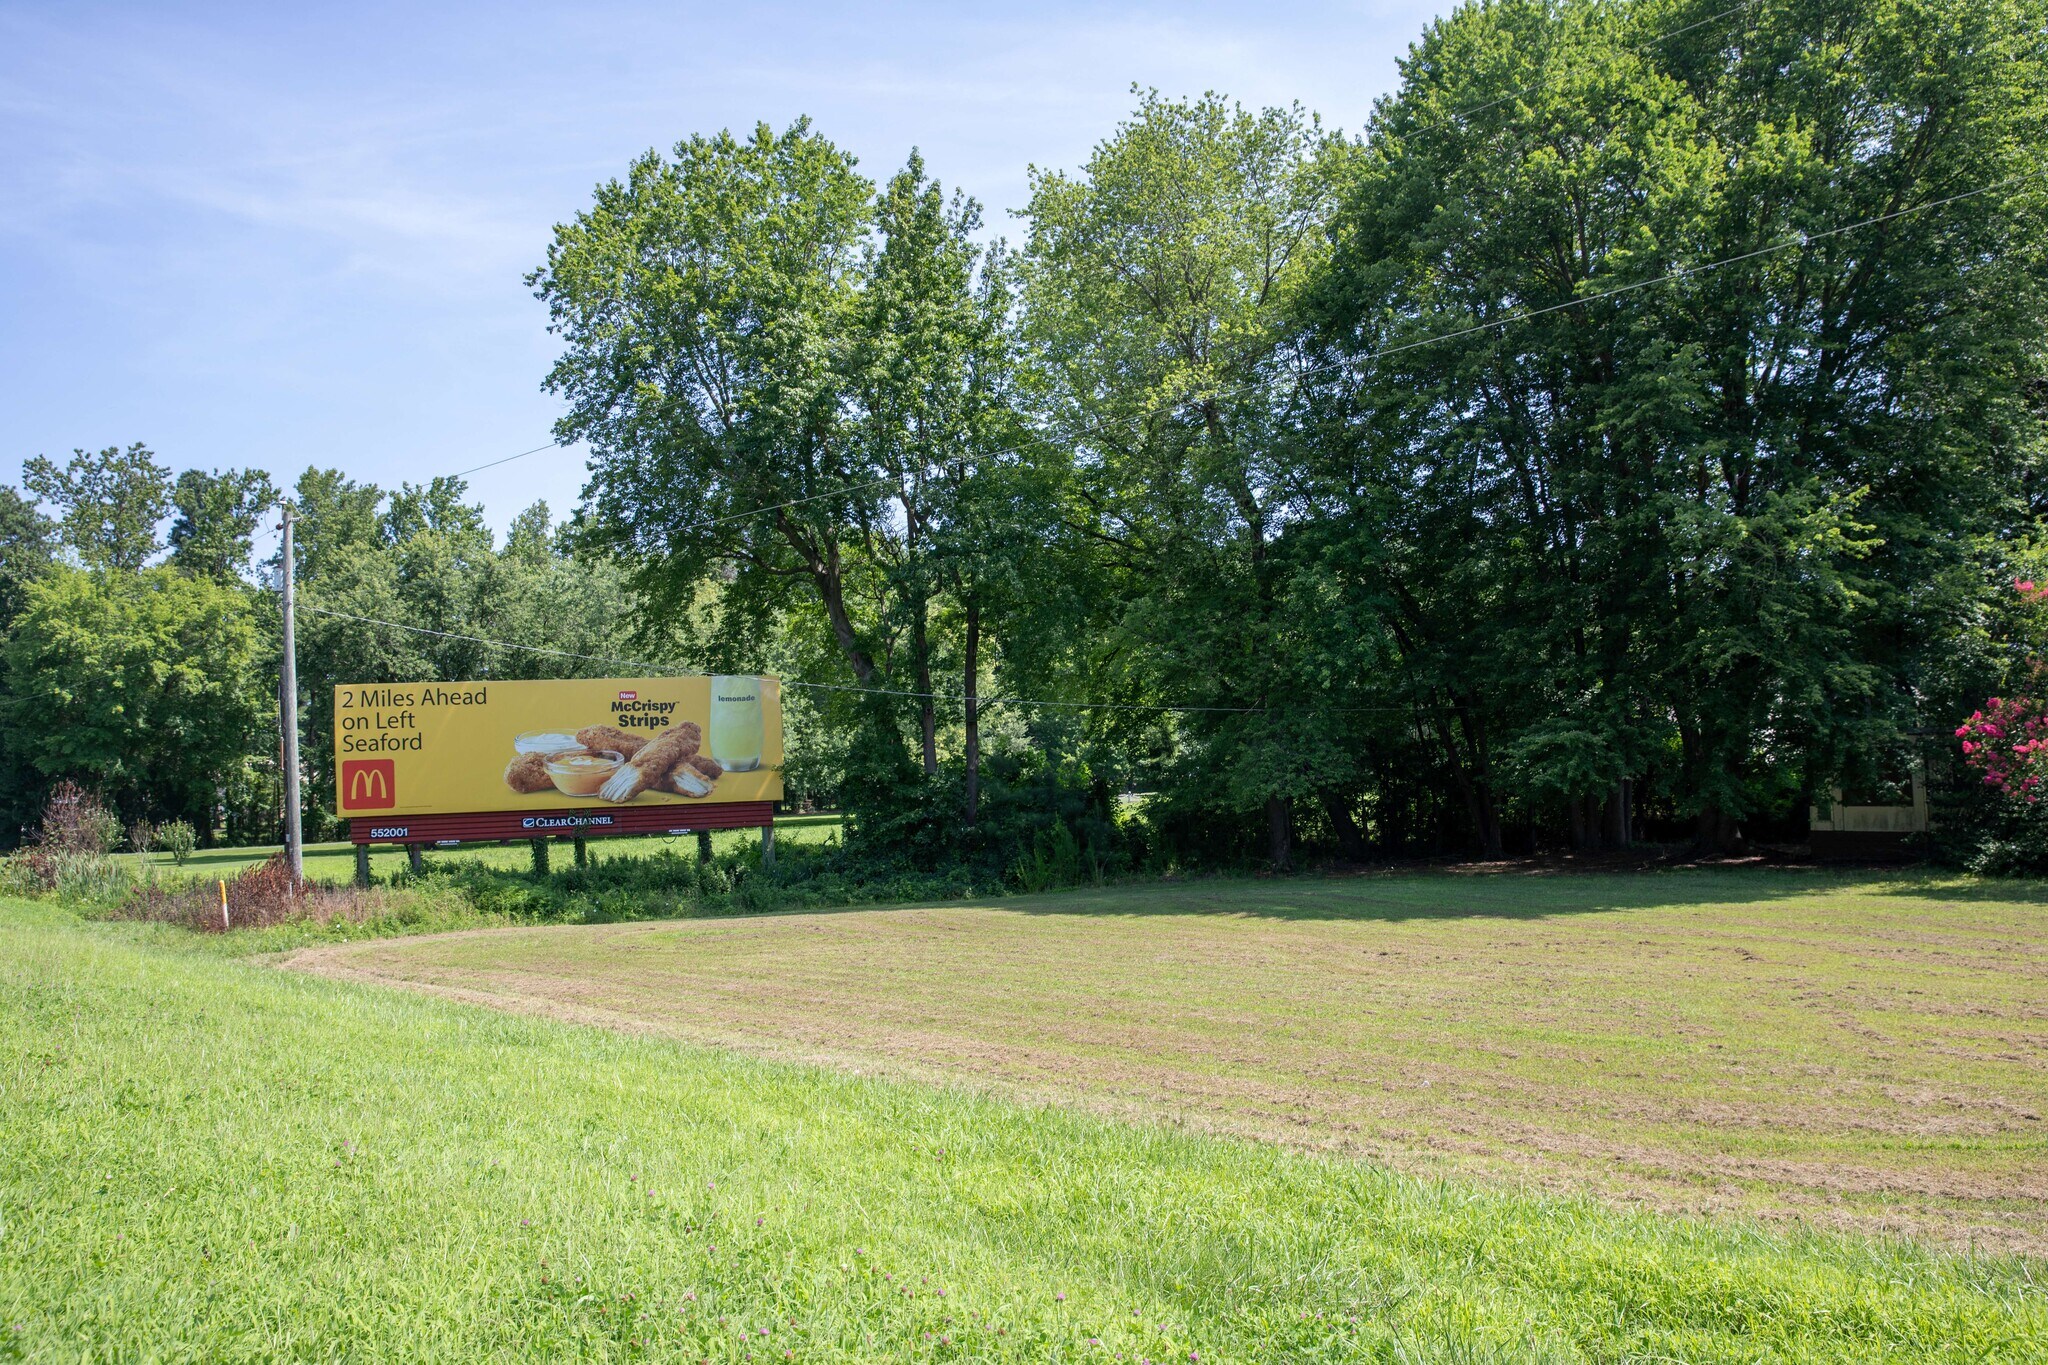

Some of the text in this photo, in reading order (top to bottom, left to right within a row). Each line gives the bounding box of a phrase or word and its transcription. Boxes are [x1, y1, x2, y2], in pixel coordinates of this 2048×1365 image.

[342, 686, 487, 708] 2 Miles Ahead
[718, 694, 756, 702] lemonade
[342, 710, 415, 730] on Left
[618, 712, 670, 730] Strips
[342, 732, 422, 752] Seaford
[370, 827, 408, 838] 552001
